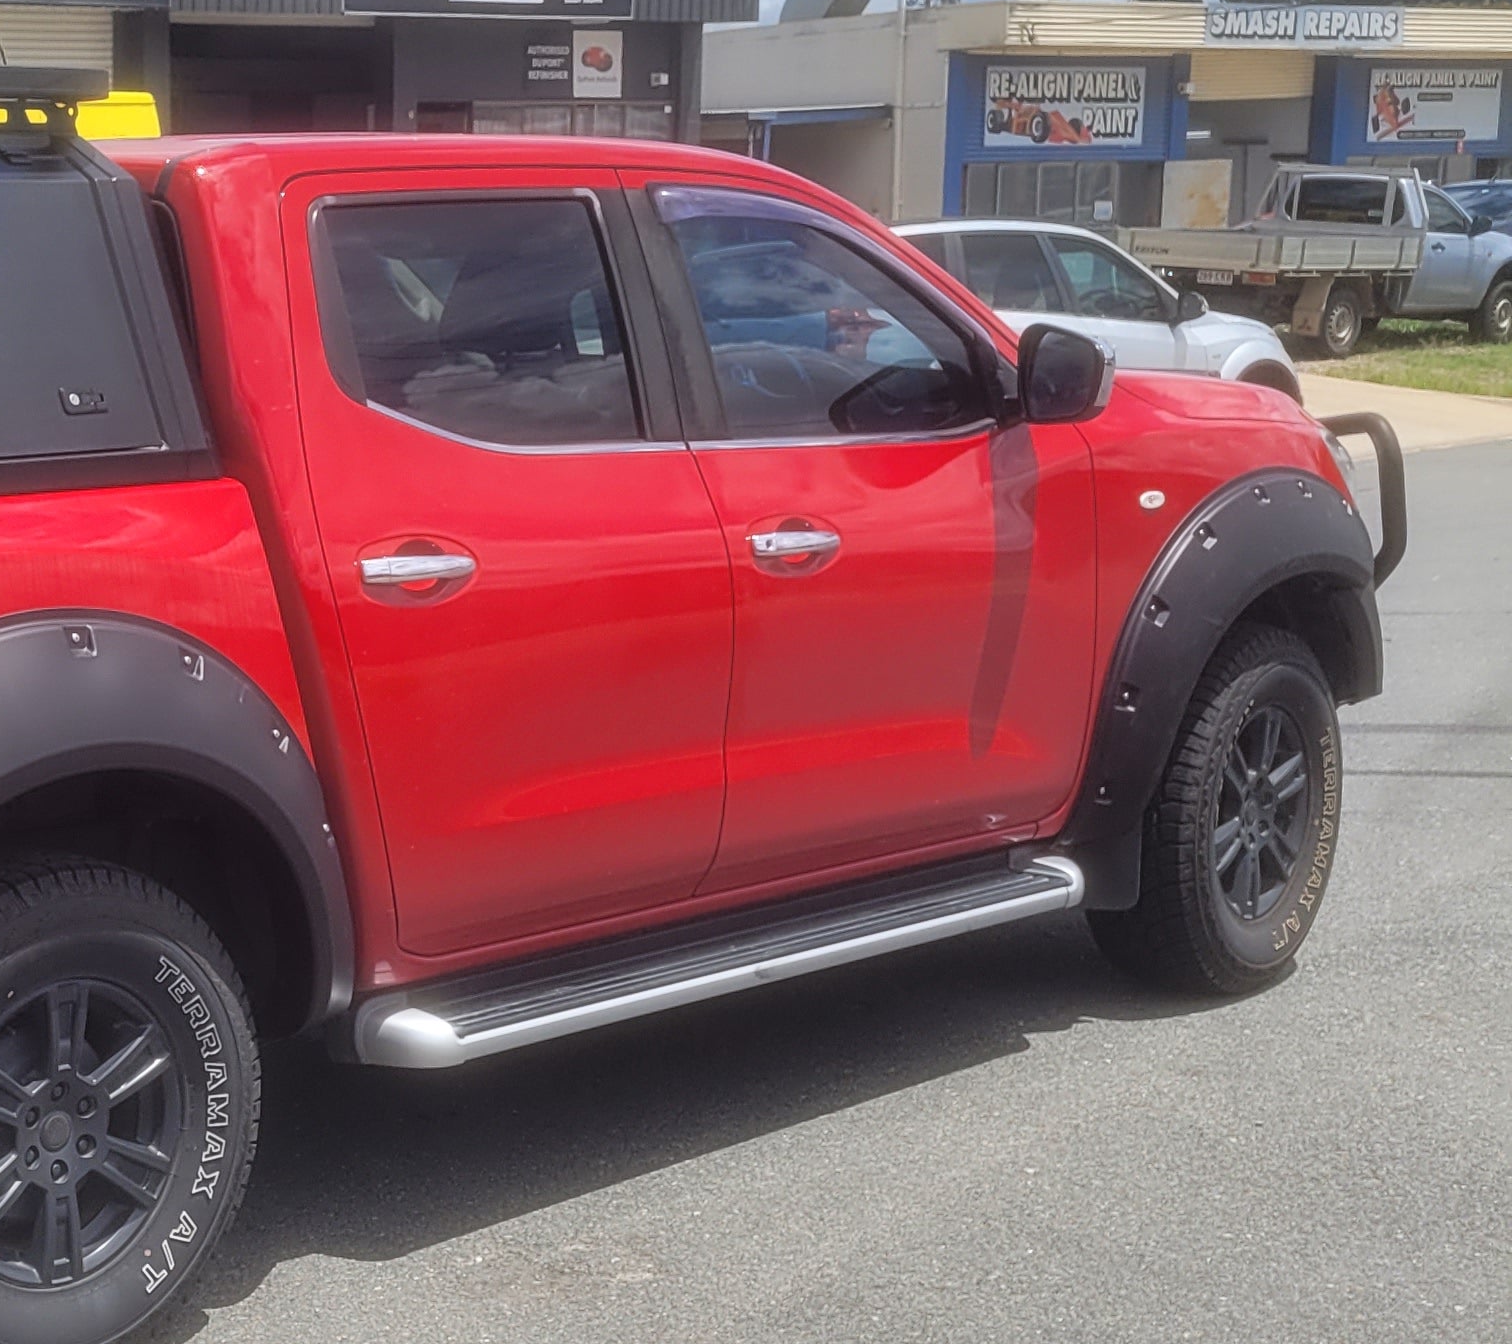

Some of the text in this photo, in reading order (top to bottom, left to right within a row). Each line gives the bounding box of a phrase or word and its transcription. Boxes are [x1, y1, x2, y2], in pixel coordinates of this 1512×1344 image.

[1210, 9, 1400, 41] SMASH REPAIRS
[989, 71, 1071, 103] RE-ALIGN
[1073, 71, 1128, 104] PANEL
[1468, 72, 1499, 89] PAINT
[1082, 107, 1139, 139] PAINT
[1299, 727, 1339, 912] TERRAMAX
[142, 955, 230, 1294] TERRAMAX A/T
